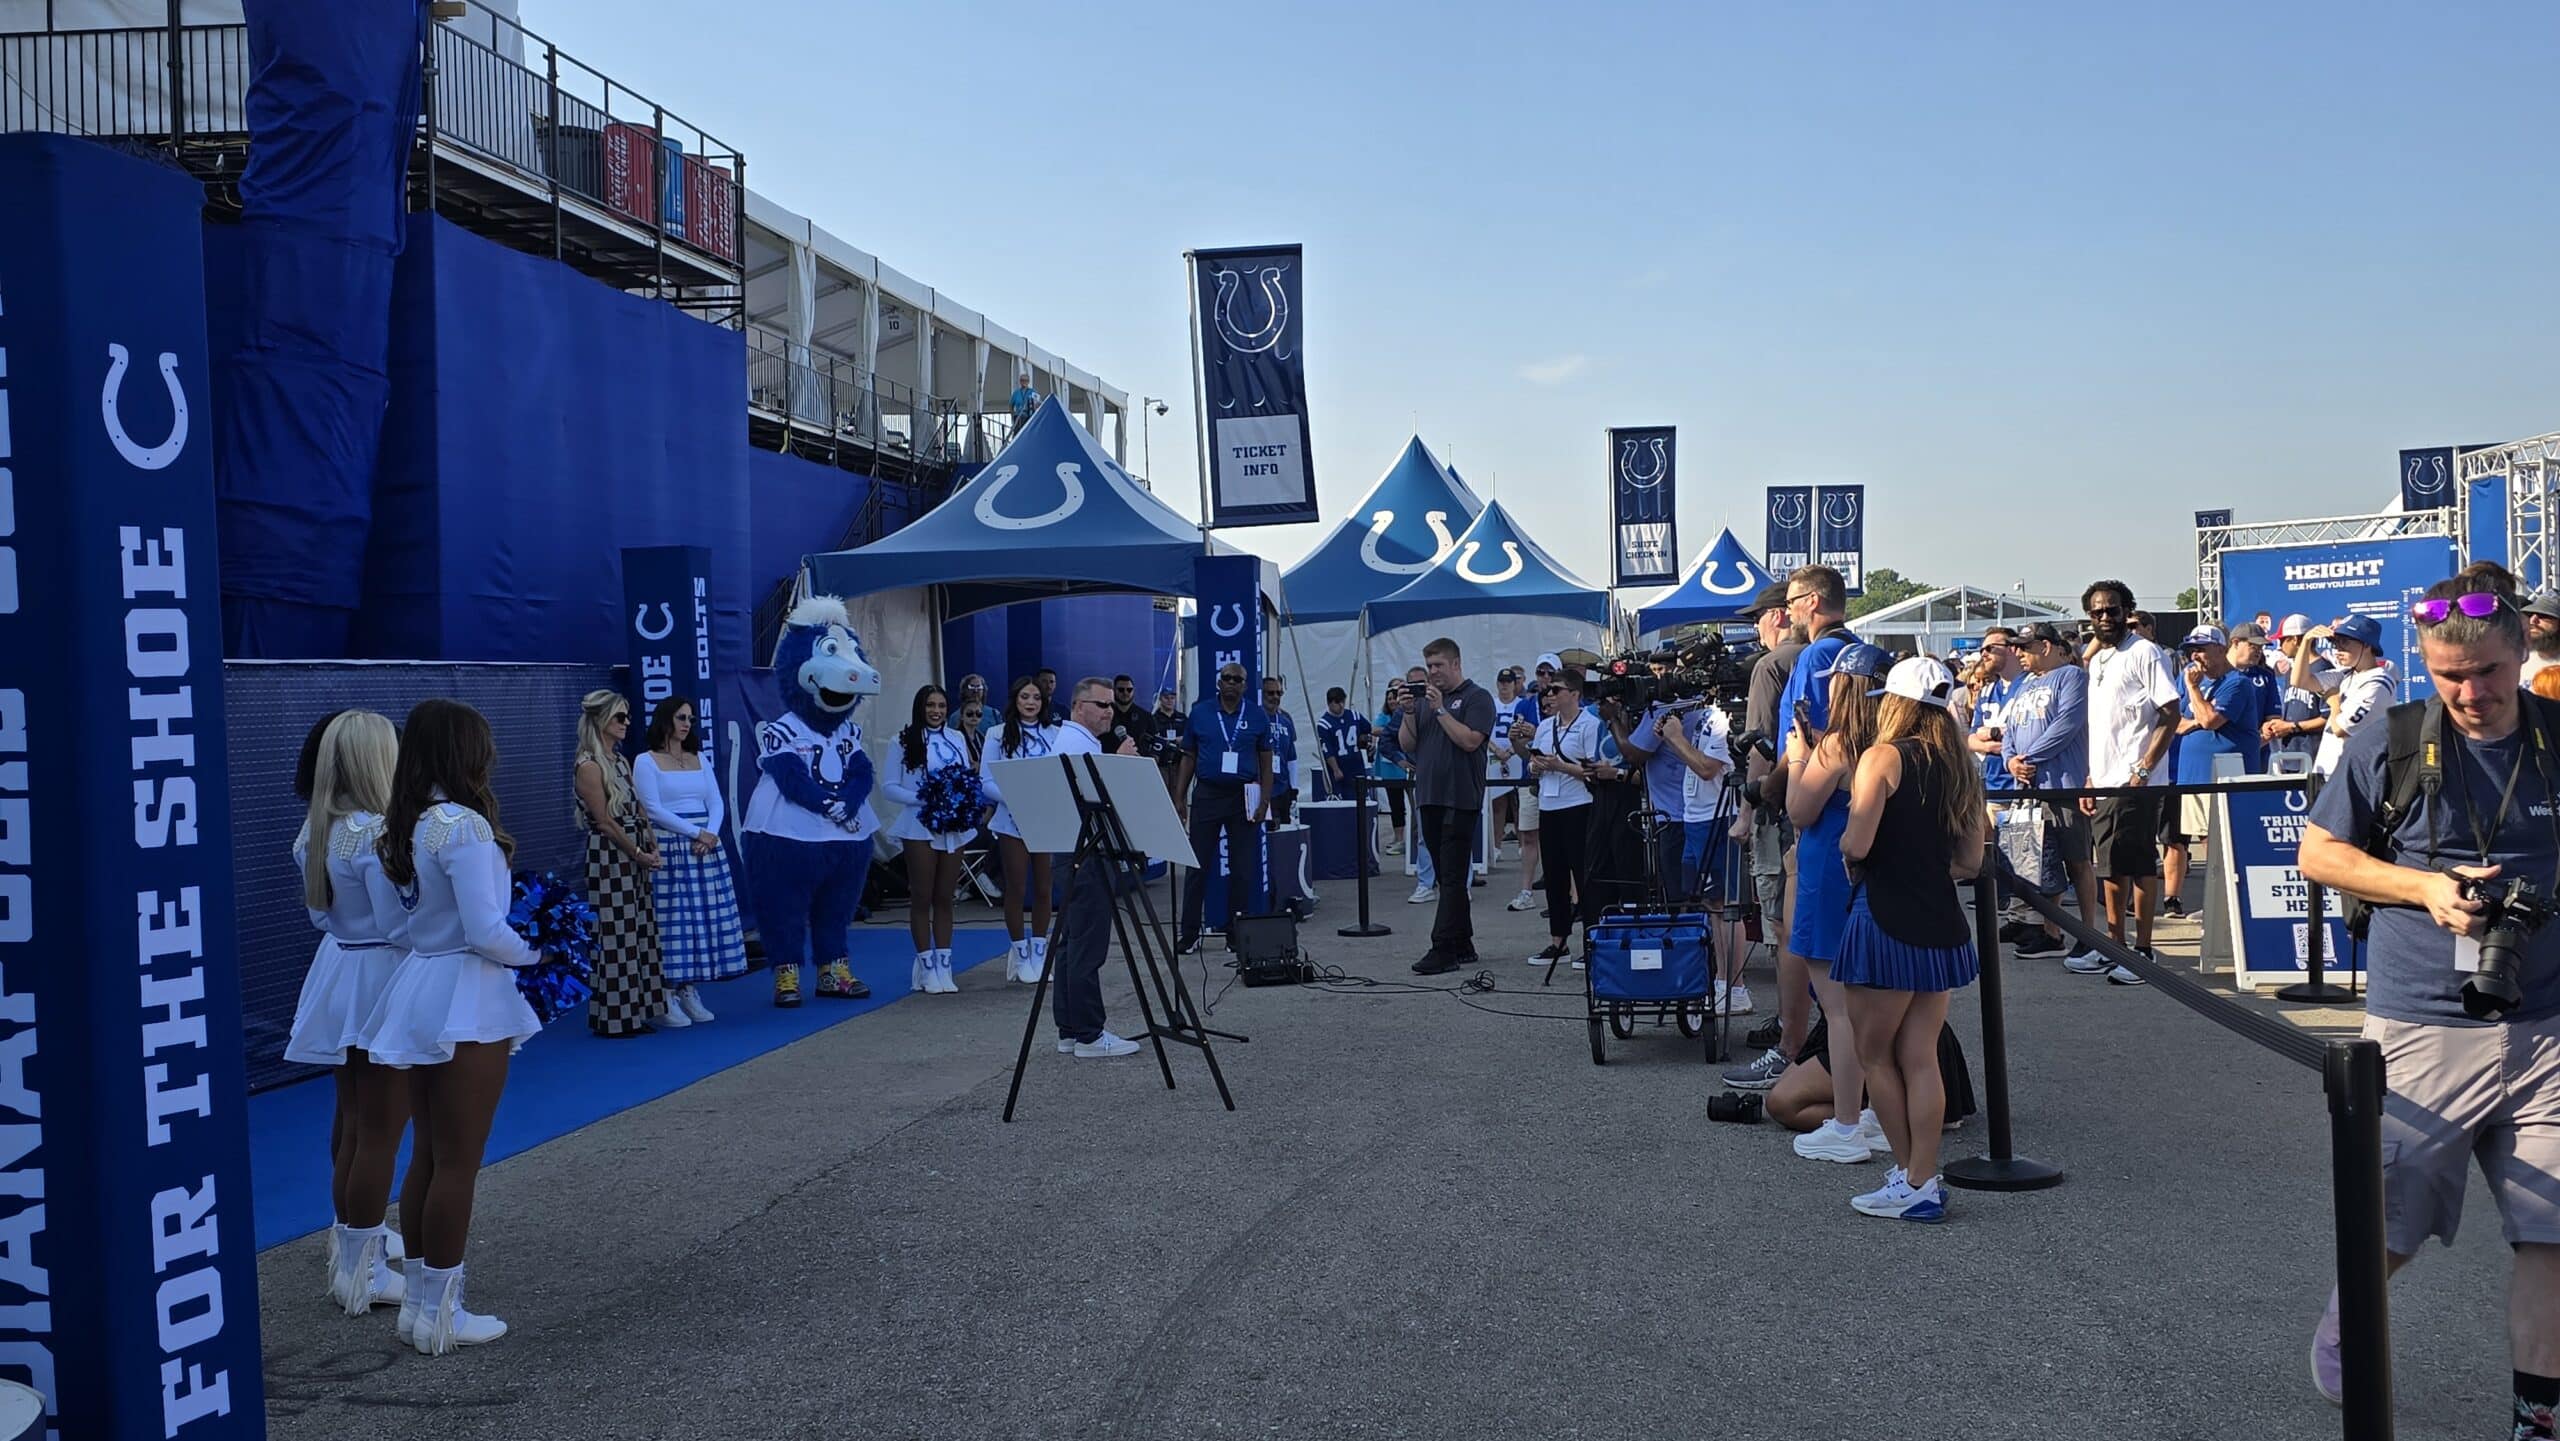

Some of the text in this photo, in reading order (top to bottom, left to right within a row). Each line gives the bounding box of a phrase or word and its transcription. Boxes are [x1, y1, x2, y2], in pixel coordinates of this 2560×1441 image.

[1233, 445, 1287, 458] TICKET
[1244, 464, 1279, 476] INFO
[1631, 541, 1659, 549] SUITE
[2284, 559, 2384, 581] HEIGHT
[693, 577, 710, 680] COLTS
[2349, 706, 2369, 724] 5
[1335, 725, 1359, 756] 14
[2260, 816, 2309, 827] TRAIN
[2286, 900, 2333, 912] HEE
[119, 526, 231, 1439] FOR THE SHOE
